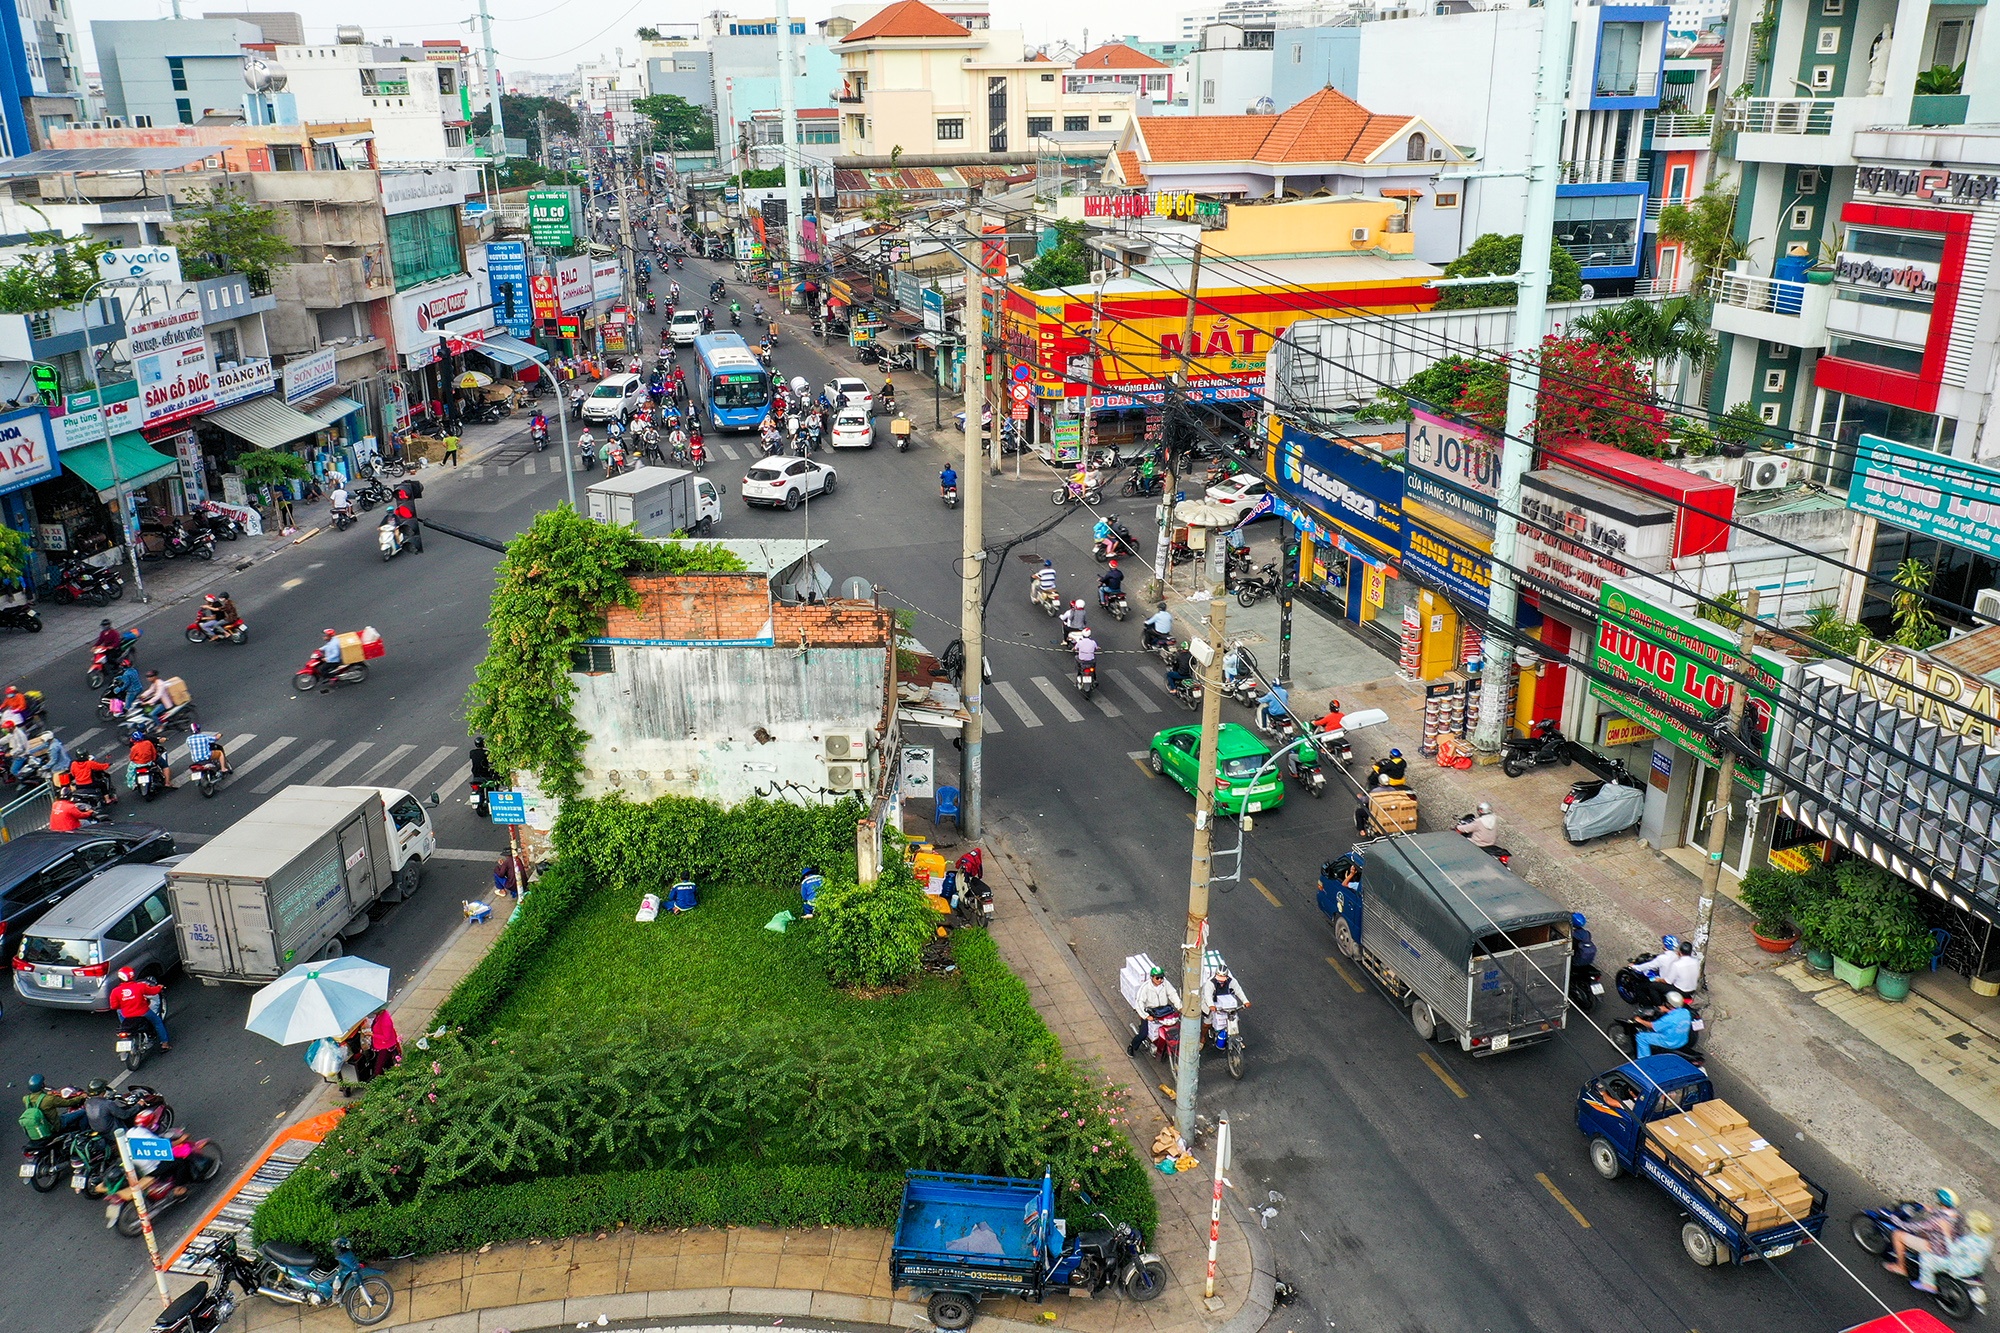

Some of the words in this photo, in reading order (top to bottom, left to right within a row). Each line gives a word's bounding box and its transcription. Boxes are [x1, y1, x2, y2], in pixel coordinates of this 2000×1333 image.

[533, 204, 547, 218] ÂU
[550, 205, 565, 217] CƠ
[1114, 195, 1151, 218] KHOA
[1155, 191, 1173, 216] ÂU
[1176, 191, 1196, 216] CƠ
[122, 248, 169, 264] vario
[561, 268, 578, 286] BALO
[449, 294, 466, 310] MART
[1160, 317, 1263, 361] MẮT
[218, 367, 254, 388] HOÀNG
[256, 362, 271, 377] MỸ
[294, 369, 312, 384] SƠN
[314, 360, 333, 375] NAM
[145, 385, 168, 407] SÀN
[169, 373, 186, 400] GỖ
[188, 371, 211, 394] ĐỨC
[1143, 381, 1162, 391] BÁN
[63, 417, 79, 428] Phụ
[81, 412, 98, 425] tùng
[113, 402, 129, 414] Chí
[10, 437, 35, 468] KỲ
[1407, 472, 1422, 492] CỬA
[1424, 481, 1444, 501] HÀNG
[1446, 491, 1461, 508] SƠN
[1462, 499, 1483, 518] MINH
[1863, 467, 1942, 509] HÙNG
[1865, 493, 1886, 507] TIỀN
[1886, 500, 1908, 515] CỦA
[1909, 507, 1932, 522] BẠN
[1932, 514, 1959, 530] PHẢI
[1960, 521, 1976, 535] VỀ
[1974, 527, 1993, 541] TÚI
[1410, 531, 1450, 567] MINH
[1534, 550, 1551, 568] ĐIỆN
[1576, 568, 1591, 587] PHỤ
[1628, 607, 1652, 629] CÔNG
[1653, 620, 1664, 635] TY
[1666, 625, 1679, 642] CỔ
[1680, 634, 1705, 656] PHẦN
[1706, 646, 1720, 662] DV
[1598, 618, 1677, 684] HÙNG
[1598, 657, 1611, 673] UY
[1850, 637, 1995, 747] KARA
[190, 932, 215, 943] 705.25
[193, 923, 208, 932] 51C
[136, 1148, 151, 1157] ÂU
